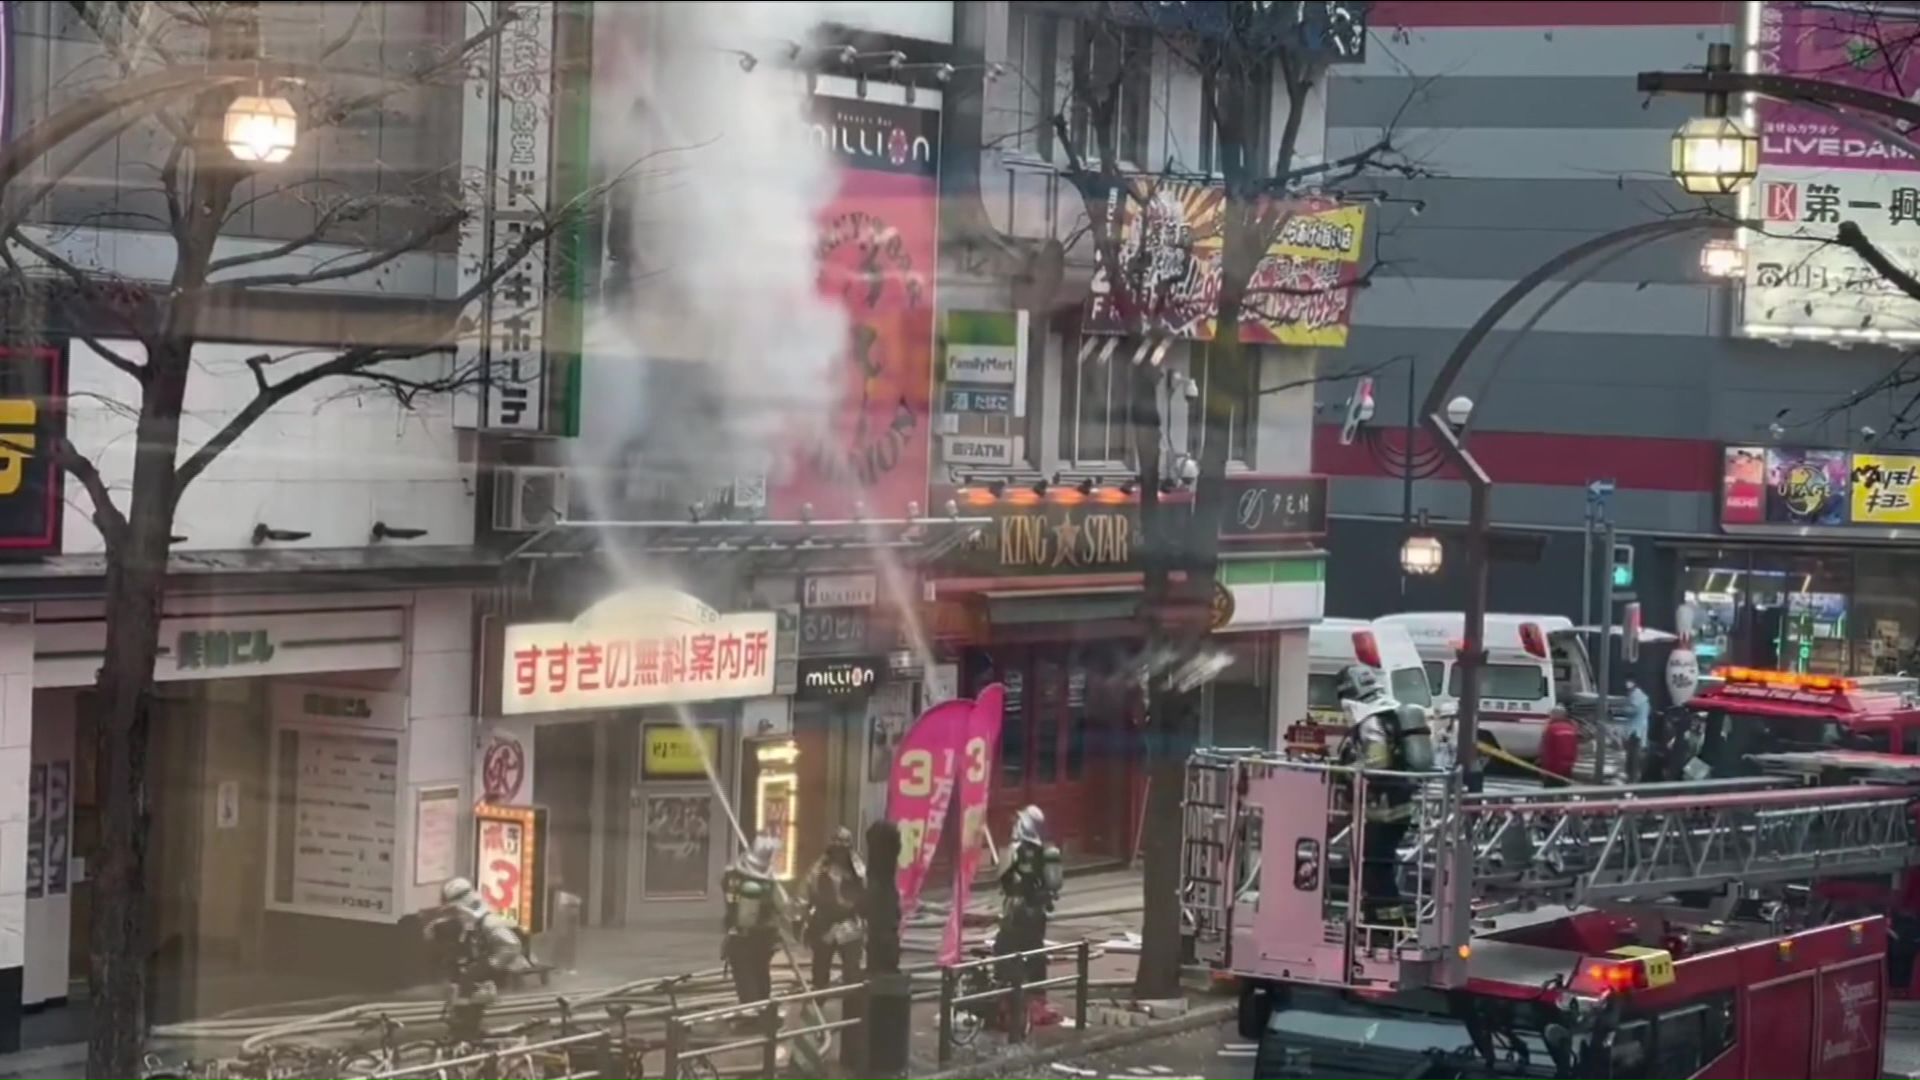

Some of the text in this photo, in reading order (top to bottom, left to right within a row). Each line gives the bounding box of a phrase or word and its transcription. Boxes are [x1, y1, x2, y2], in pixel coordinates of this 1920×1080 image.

[949, 355, 1013, 374] FamilyMart
[1865, 488, 1910, 513] キヨシ
[1001, 514, 1048, 565] KING
[1084, 513, 1128, 564] STAR
[513, 629, 769, 696] すすきの無料案内所
